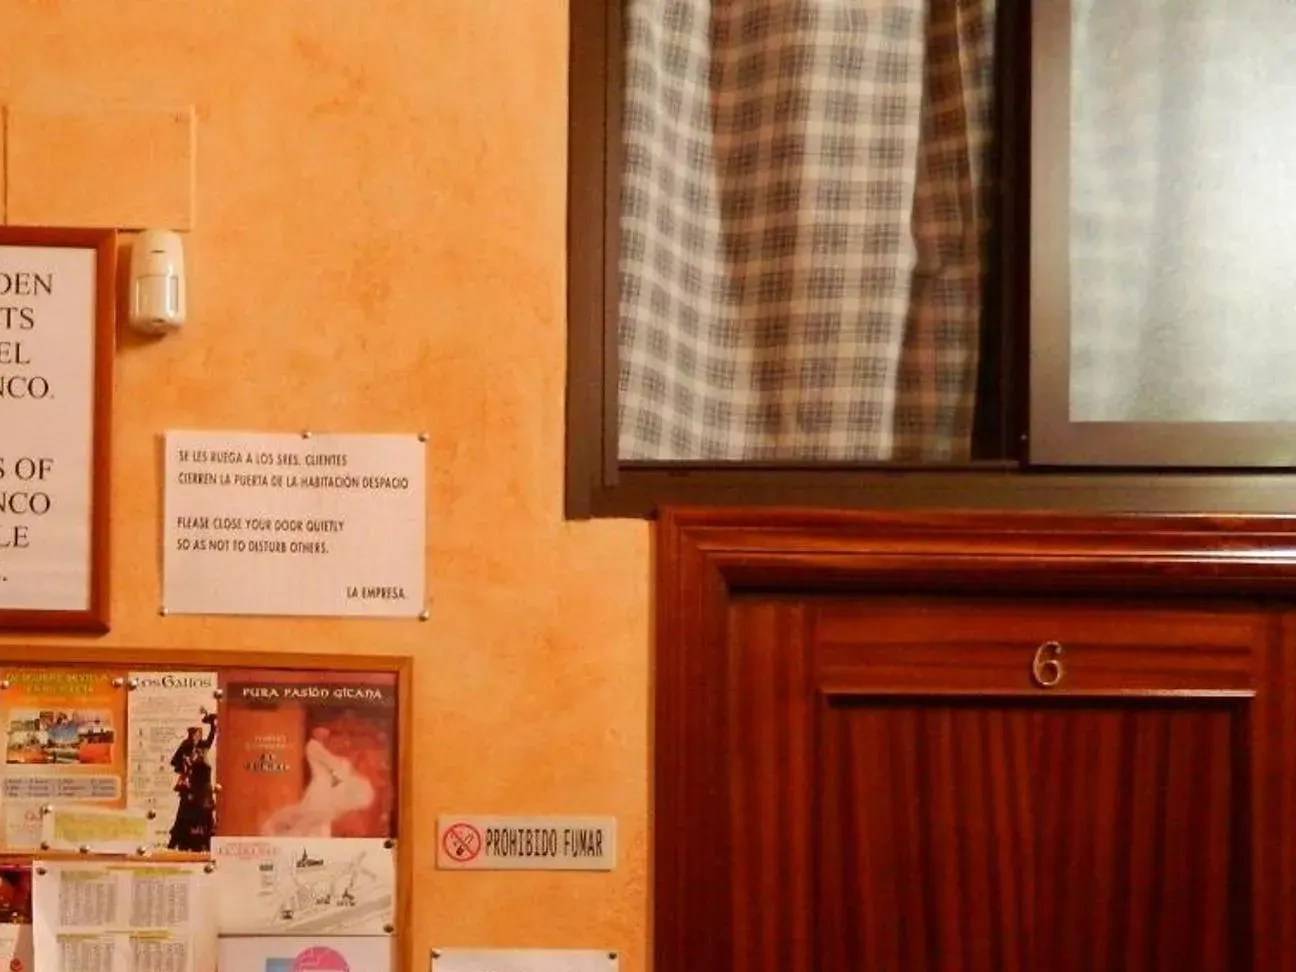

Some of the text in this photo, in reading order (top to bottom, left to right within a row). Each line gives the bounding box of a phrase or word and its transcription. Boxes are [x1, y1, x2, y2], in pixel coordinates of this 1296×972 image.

[178, 450, 189, 463] SE
[192, 451, 208, 463] LES
[210, 451, 243, 465] RUEGA
[245, 452, 254, 465] A
[256, 452, 274, 466] LOS
[305, 454, 348, 467] CLIENTES
[14, 458, 54, 481] OF
[178, 472, 217, 485] CIERREN
[219, 473, 232, 486] LA
[234, 474, 268, 487] PUERTA
[270, 475, 284, 488] DE
[286, 475, 298, 488] LA
[361, 477, 409, 490] DESPACIO
[177, 516, 345, 532] PLEASE CLOSE YOUR DOOR QUIETLY
[177, 538, 330, 555] SO AS NOT TO DISTURB OTHERS.
[347, 586, 359, 599] LA
[1032, 640, 1063, 687] 6
[485, 828, 603, 857] PROHIBIDO FUMAR
